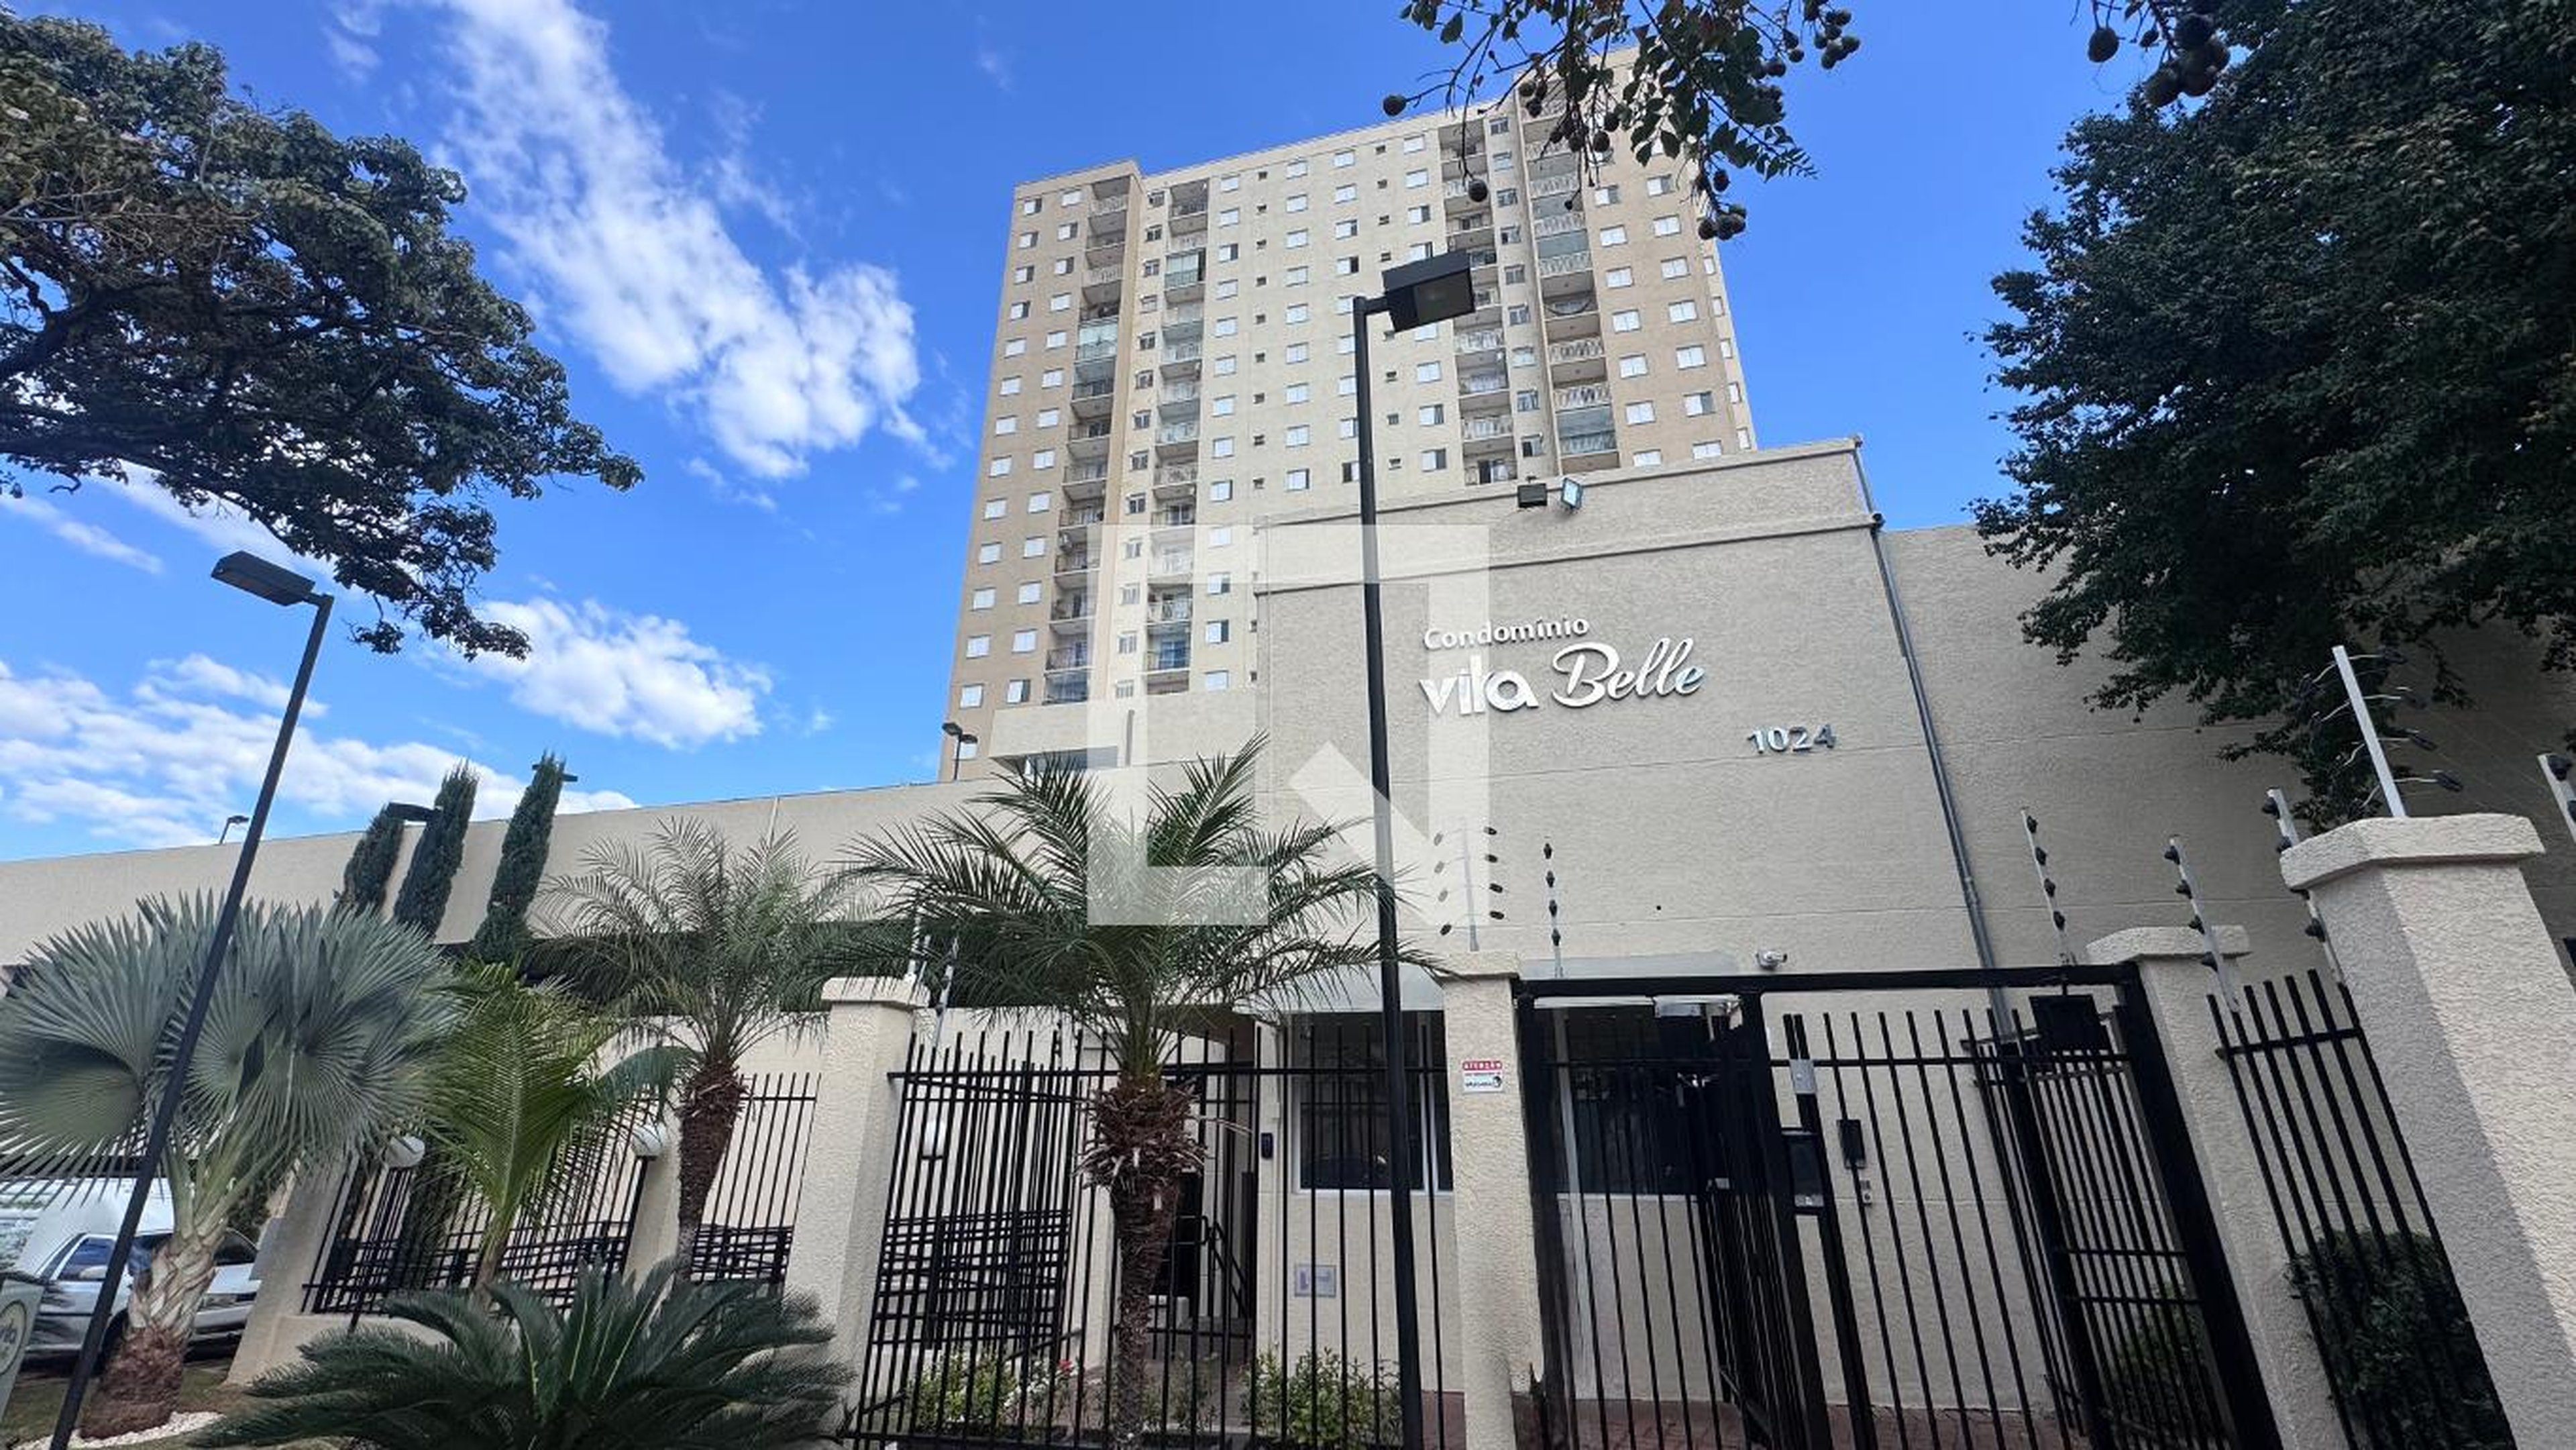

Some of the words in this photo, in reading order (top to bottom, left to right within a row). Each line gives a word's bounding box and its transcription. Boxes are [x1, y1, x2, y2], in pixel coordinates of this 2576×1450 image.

[1424, 617, 1589, 650] Condomínio
[1552, 637, 1705, 708] Belle
[1747, 725, 1836, 754] 1024
